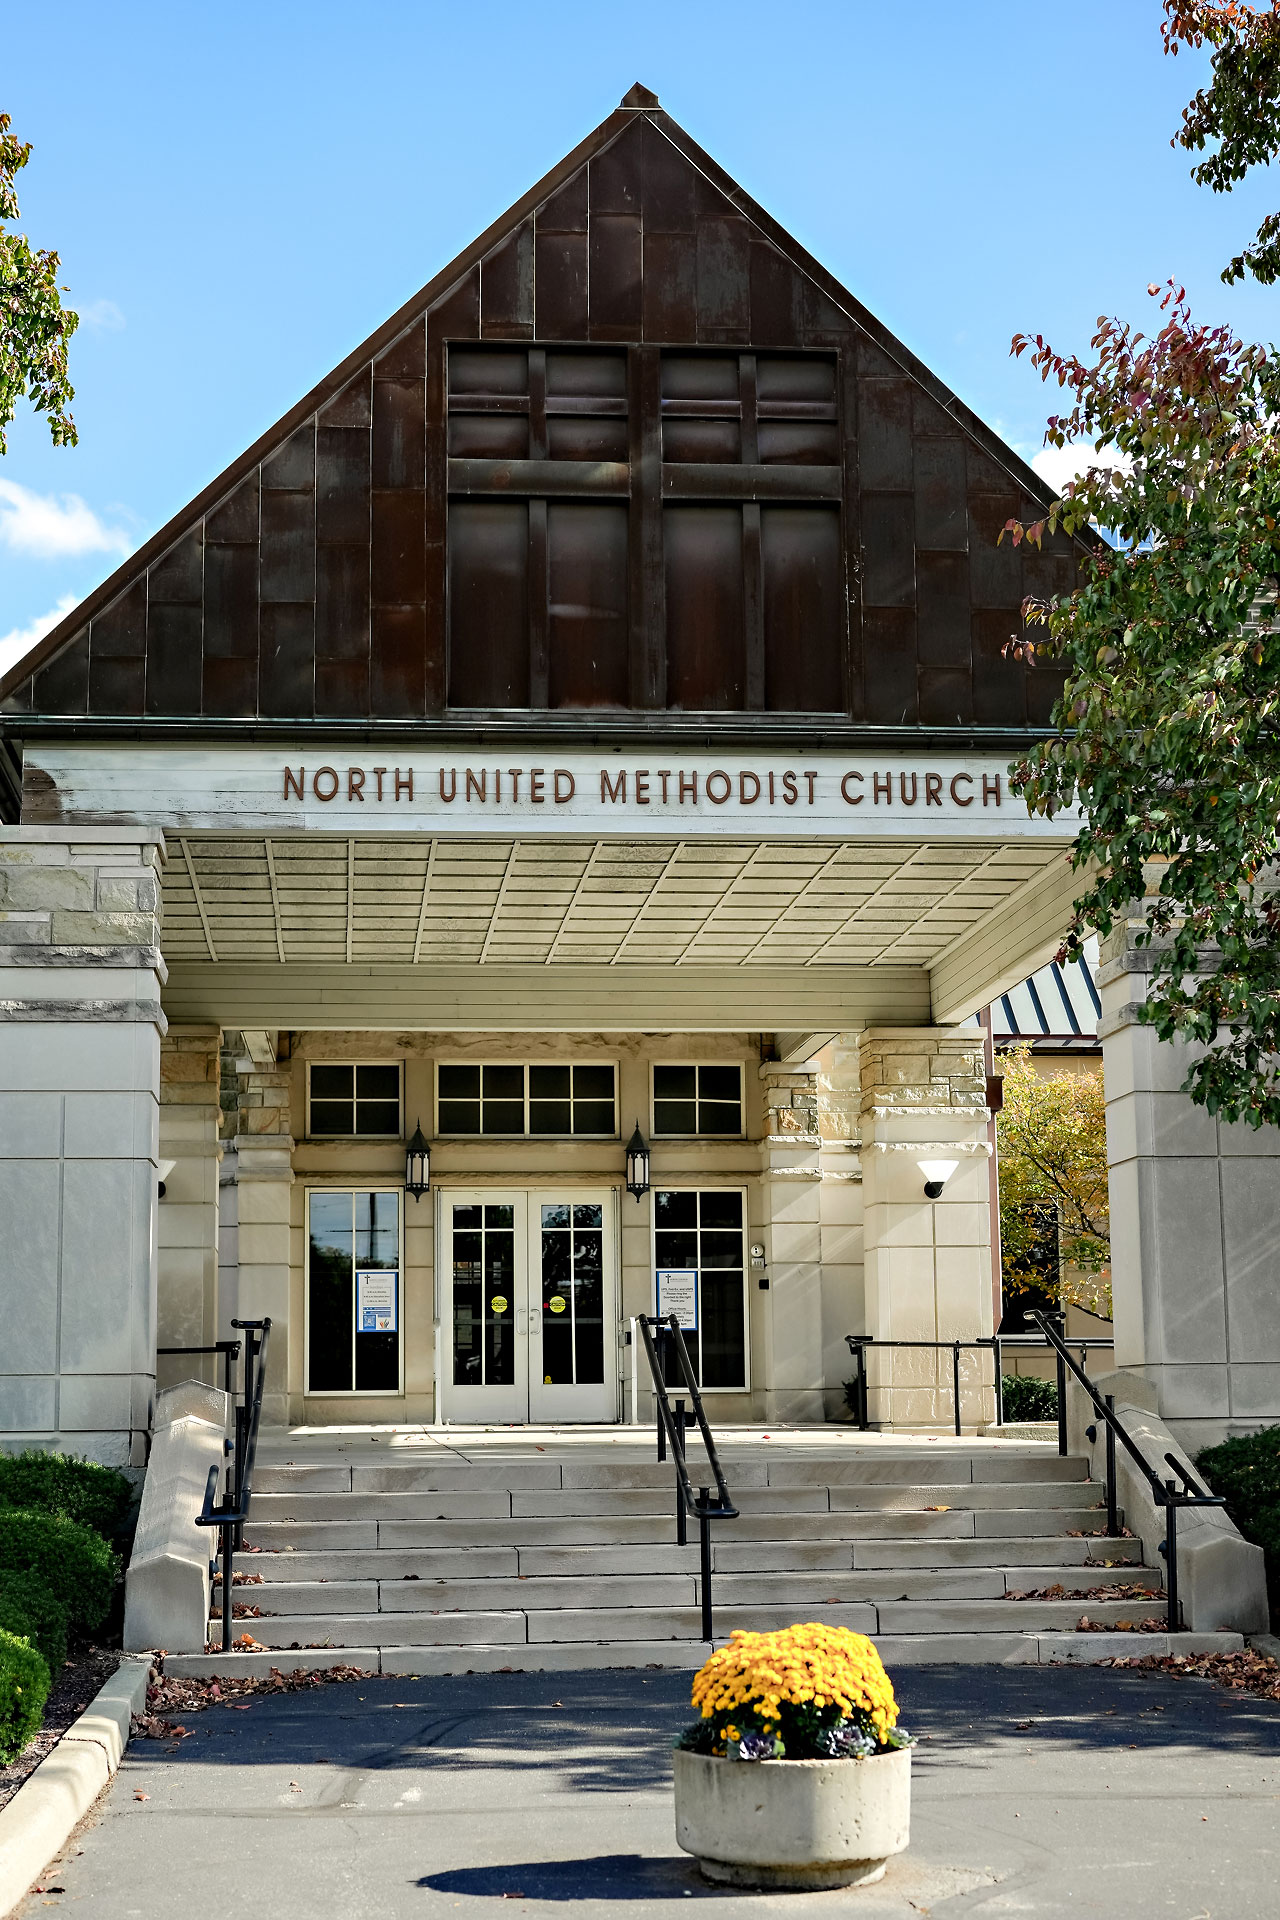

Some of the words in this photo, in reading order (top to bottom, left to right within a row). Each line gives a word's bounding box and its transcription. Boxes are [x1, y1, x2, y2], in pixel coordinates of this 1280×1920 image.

[284, 766, 413, 802] NORTH
[440, 768, 576, 804] UNITED
[601, 769, 818, 805] METHODIST
[840, 771, 1001, 806] CHURCH
